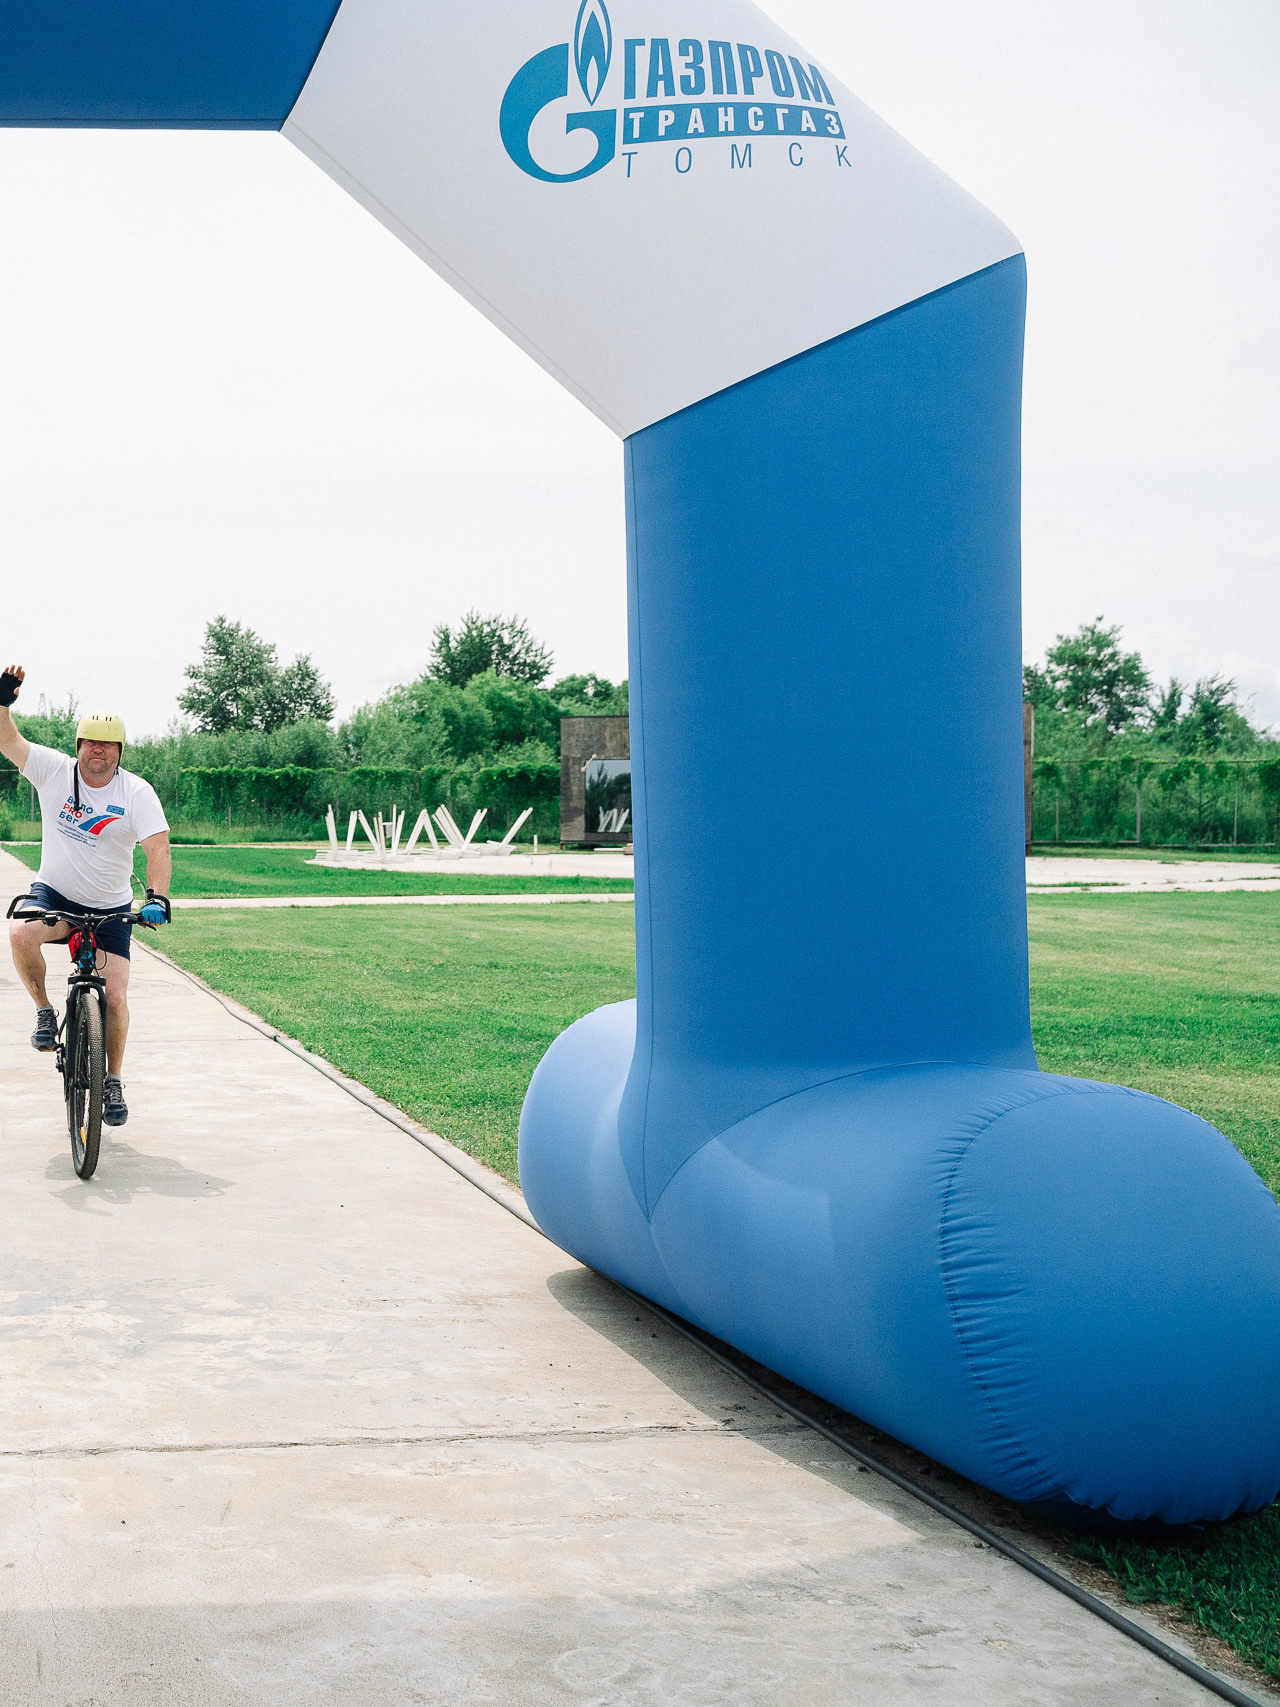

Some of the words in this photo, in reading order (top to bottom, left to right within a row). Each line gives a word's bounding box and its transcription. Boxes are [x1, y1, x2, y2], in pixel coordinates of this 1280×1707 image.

[623, 38, 836, 107] ГАЗПРОМ
[628, 106, 841, 140] ТРАНСГАЗ
[622, 142, 852, 178] ТОМСК
[59, 811, 78, 824] Бег
[63, 803, 83, 818] PRO
